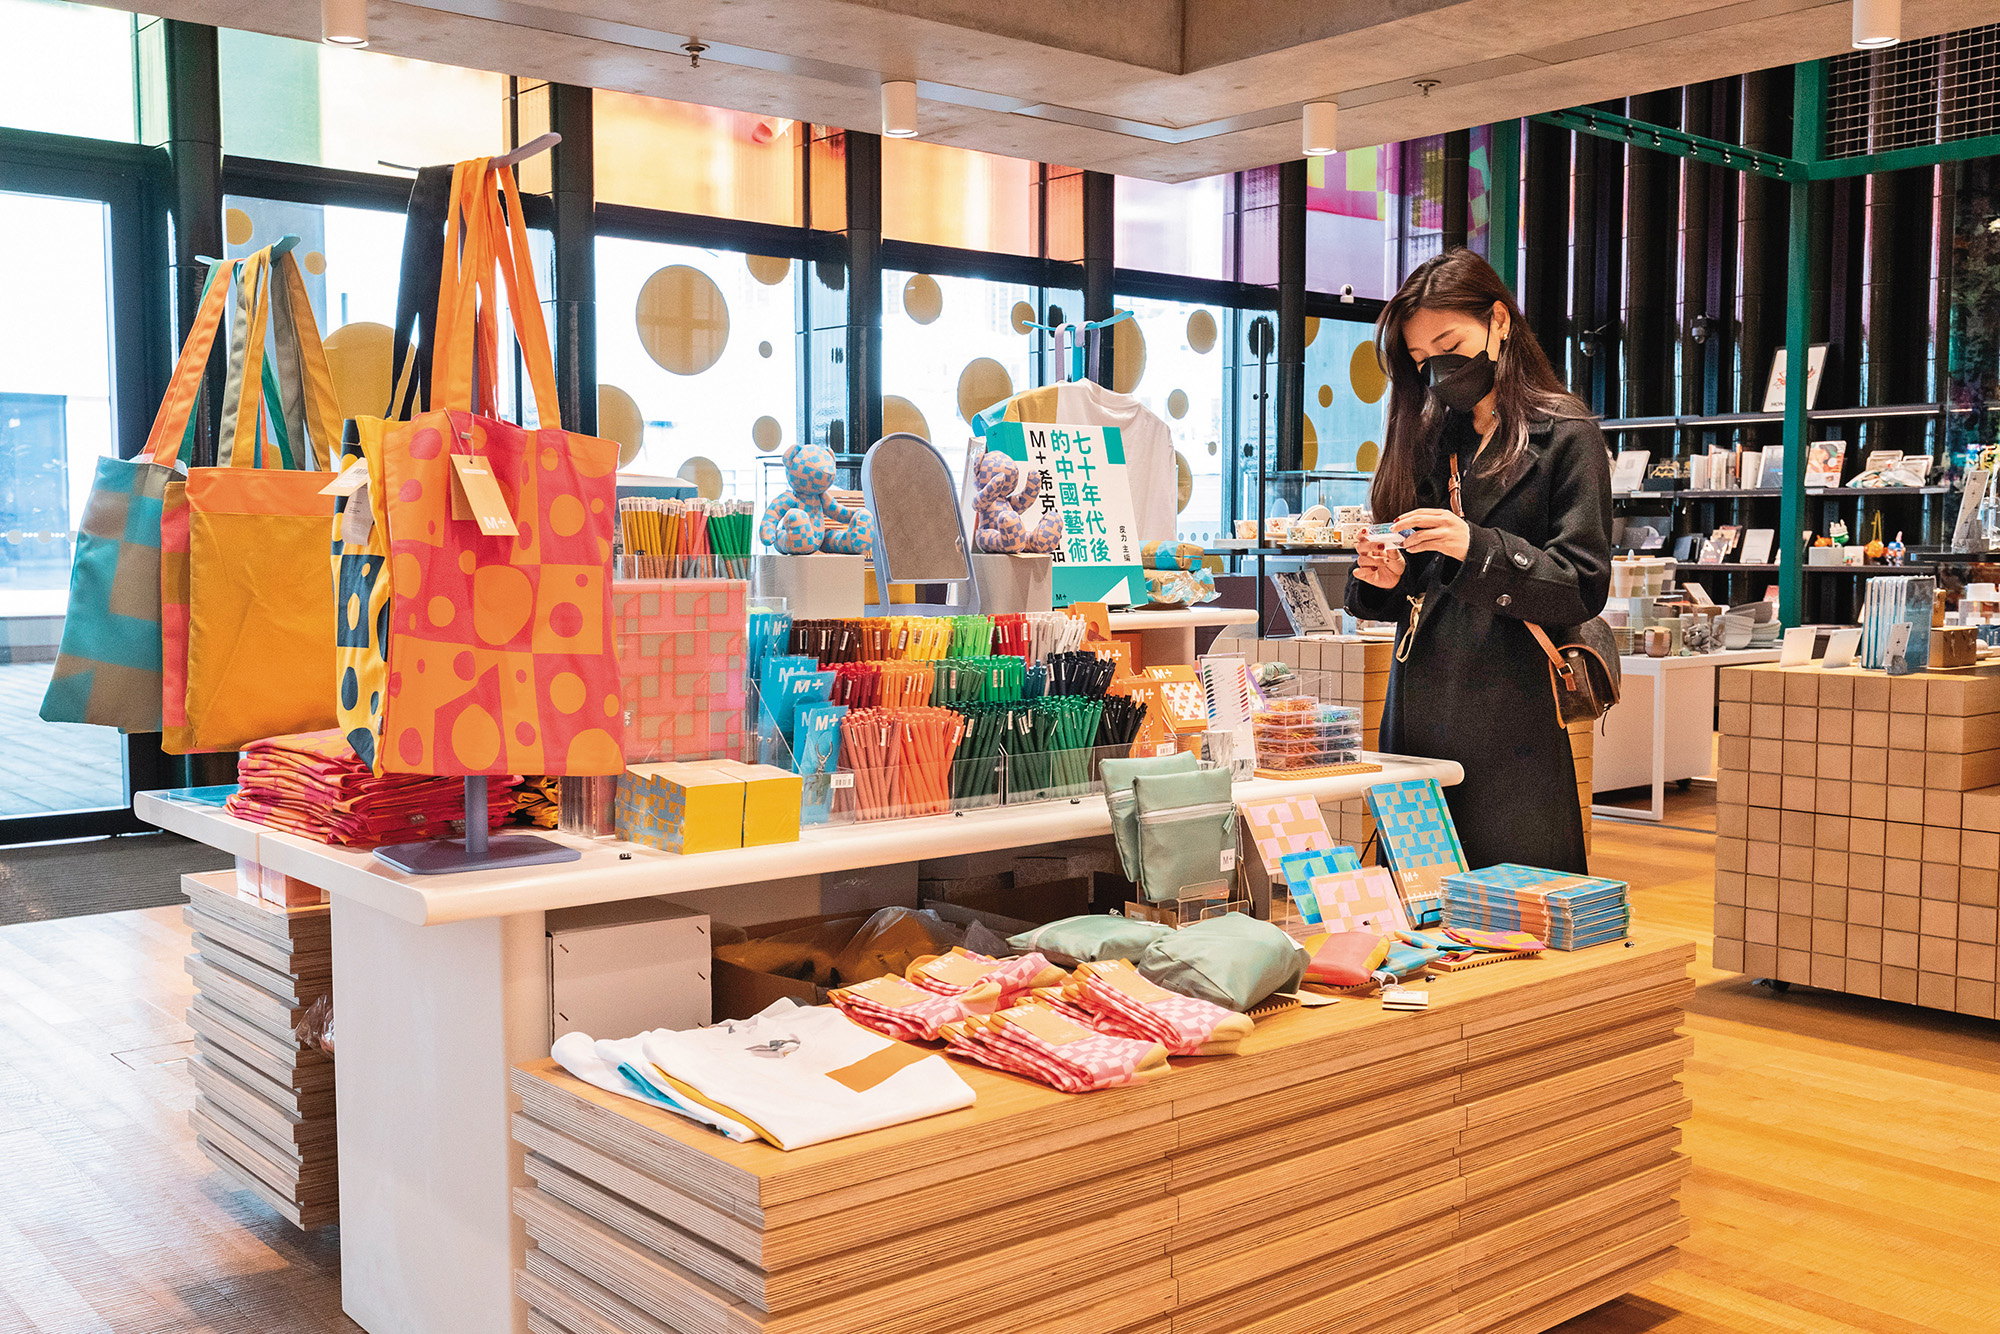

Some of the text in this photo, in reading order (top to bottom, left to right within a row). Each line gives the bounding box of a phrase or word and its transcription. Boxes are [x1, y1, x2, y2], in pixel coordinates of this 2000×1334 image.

[1029, 430, 1066, 563] M+希克品
[1050, 429, 1088, 563] 的中國藝術
[1072, 430, 1112, 563] 七十年代後
[483, 516, 507, 529] M+
[1055, 593, 1067, 601] M+
[772, 620, 788, 636] M+
[1152, 668, 1173, 680] M+
[793, 678, 824, 694] M+
[1131, 687, 1155, 703] M+
[815, 713, 839, 732] M+
[1403, 871, 1419, 883] M+
[927, 955, 955, 973] M+
[1095, 961, 1120, 974] M+
[852, 978, 882, 991] M+
[1005, 1004, 1035, 1019] M+
